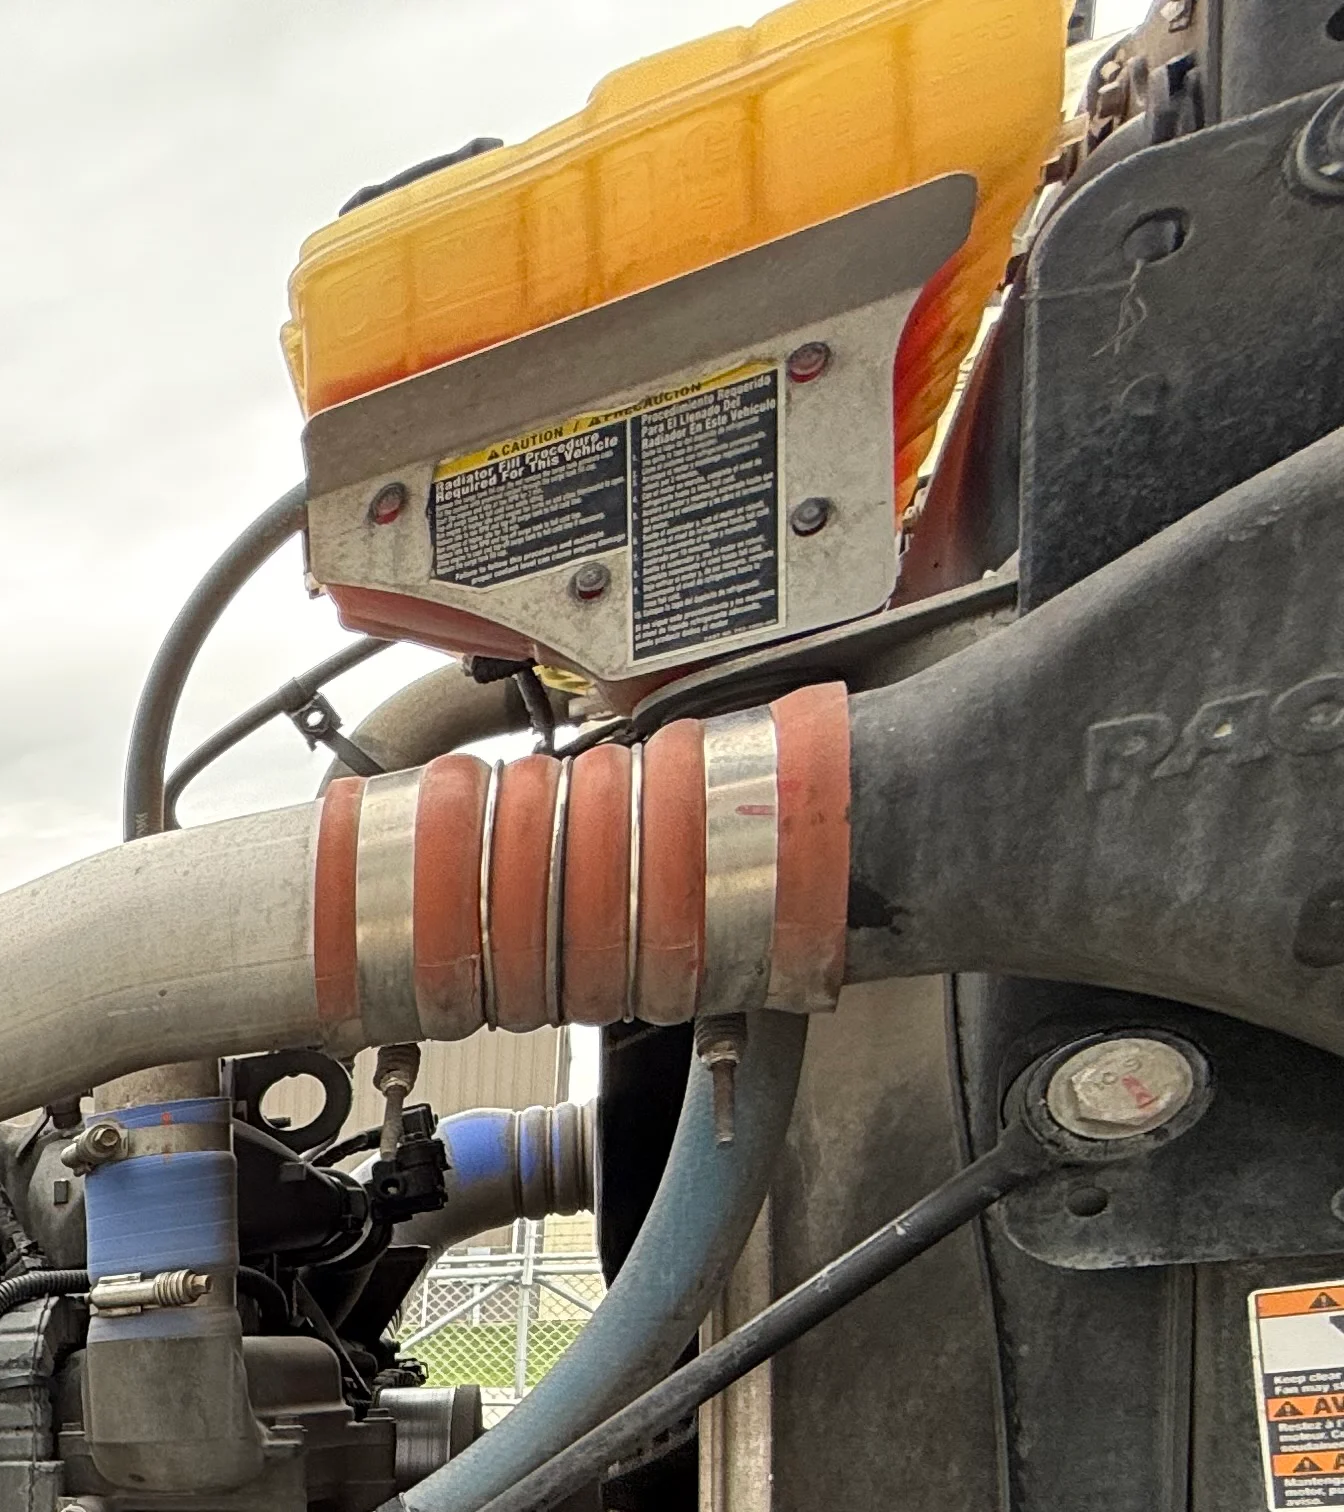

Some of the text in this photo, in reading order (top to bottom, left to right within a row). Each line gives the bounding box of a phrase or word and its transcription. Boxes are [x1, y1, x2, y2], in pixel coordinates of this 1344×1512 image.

[436, 433, 600, 492] Radiator Fill Procedure
[436, 436, 619, 503] Required For This Vehicle
[501, 426, 564, 456] CAUTION
